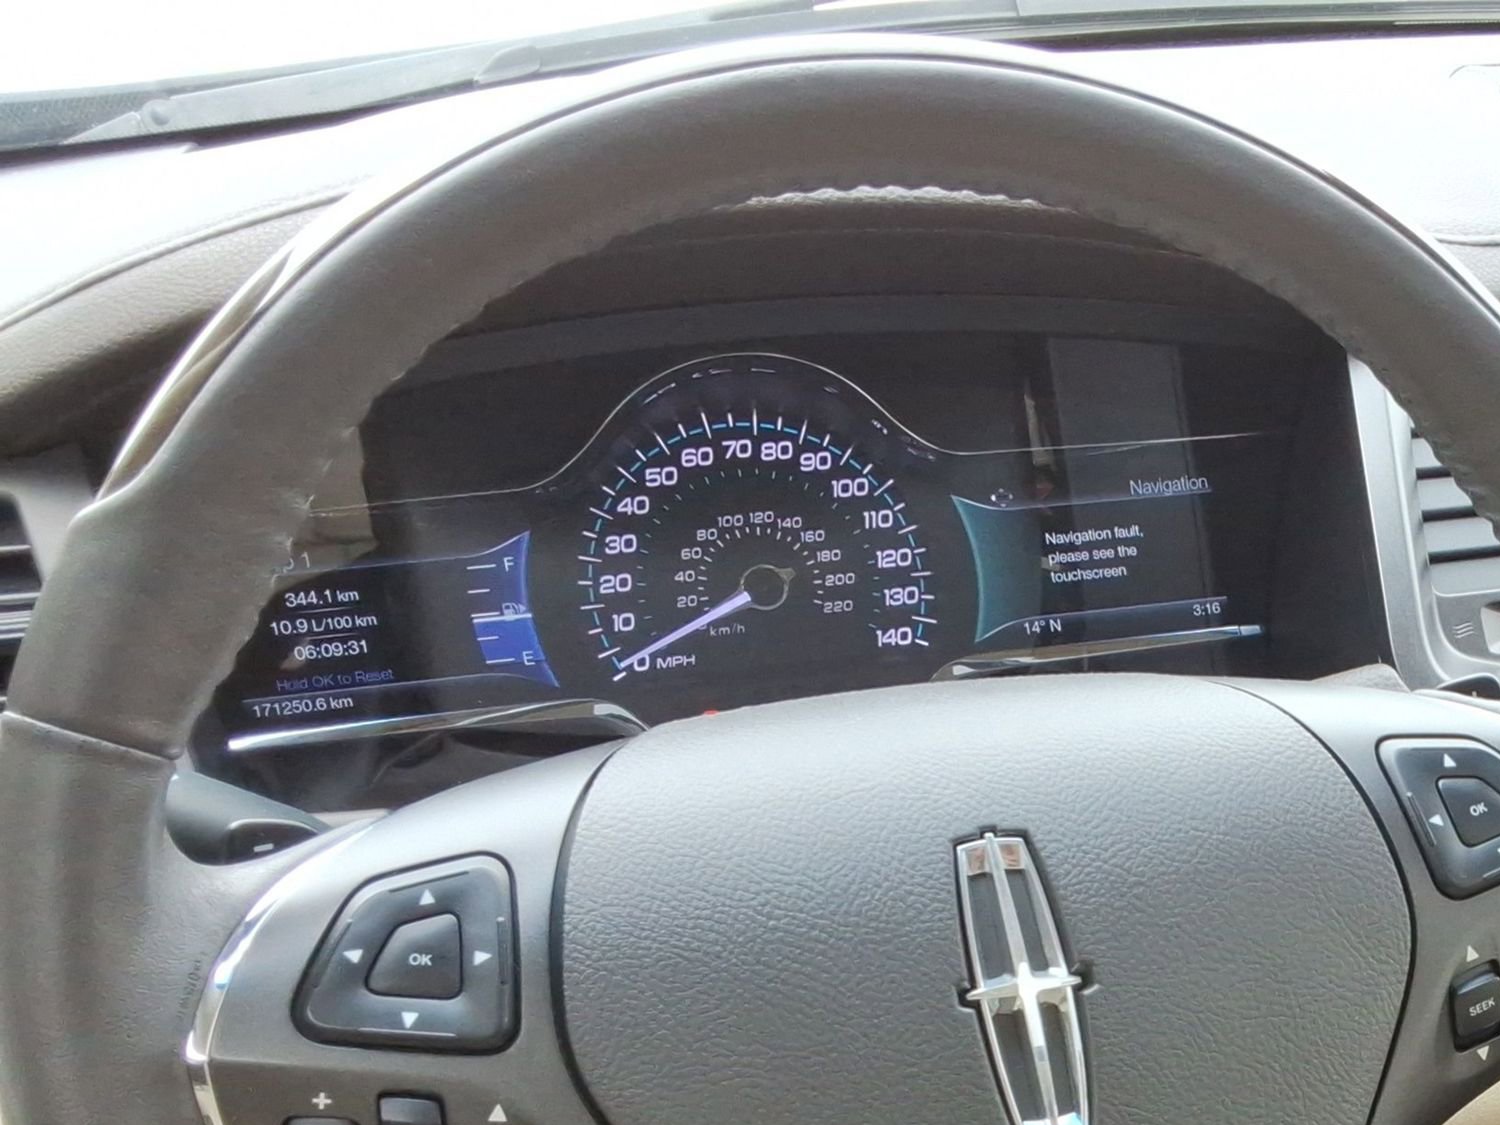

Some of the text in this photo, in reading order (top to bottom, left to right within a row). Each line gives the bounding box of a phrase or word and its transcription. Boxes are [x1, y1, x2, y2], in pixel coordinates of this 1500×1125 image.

[681, 447, 714, 467] 60
[722, 439, 752, 459] 70
[760, 441, 793, 461] 80
[800, 452, 831, 472] 90
[645, 467, 678, 487] 50
[1129, 475, 1209, 497] Navigation
[831, 477, 869, 498] 100
[616, 496, 650, 515] 40
[717, 515, 744, 528] 100
[749, 511, 774, 524] 120
[777, 516, 802, 529] 140
[863, 510, 893, 529] 110
[604, 534, 637, 554] 30
[696, 529, 718, 541] 80
[800, 530, 825, 542] 160
[1045, 525, 1144, 545] Navigation fault,
[681, 547, 702, 560] 60
[816, 550, 841, 562] 180
[876, 549, 912, 568] 120
[1048, 545, 1138, 565] please see the
[503, 557, 515, 572] F
[1050, 564, 1127, 583] touchscreen
[599, 574, 632, 594] 20
[674, 571, 696, 583] 40
[824, 573, 856, 586] 200
[284, 589, 360, 608] 344.1 km
[677, 595, 698, 608] 20
[883, 587, 919, 606] 130
[823, 600, 853, 613] 220
[1193, 602, 1221, 617] 3:16
[270, 615, 378, 636] 10.9 L/100 km
[612, 613, 635, 632] 10
[709, 623, 746, 637] km/h
[1049, 619, 1062, 633] N
[876, 628, 912, 647] 140
[294, 640, 369, 661] 06:09:31
[523, 651, 536, 666] E
[656, 654, 696, 669] MPH
[276, 669, 395, 692] Hold OK to Reset
[252, 696, 354, 718] 171250.6 km
[1469, 801, 1489, 817] OK
[409, 952, 433, 967] OK
[1469, 997, 1496, 1018] SEEK
